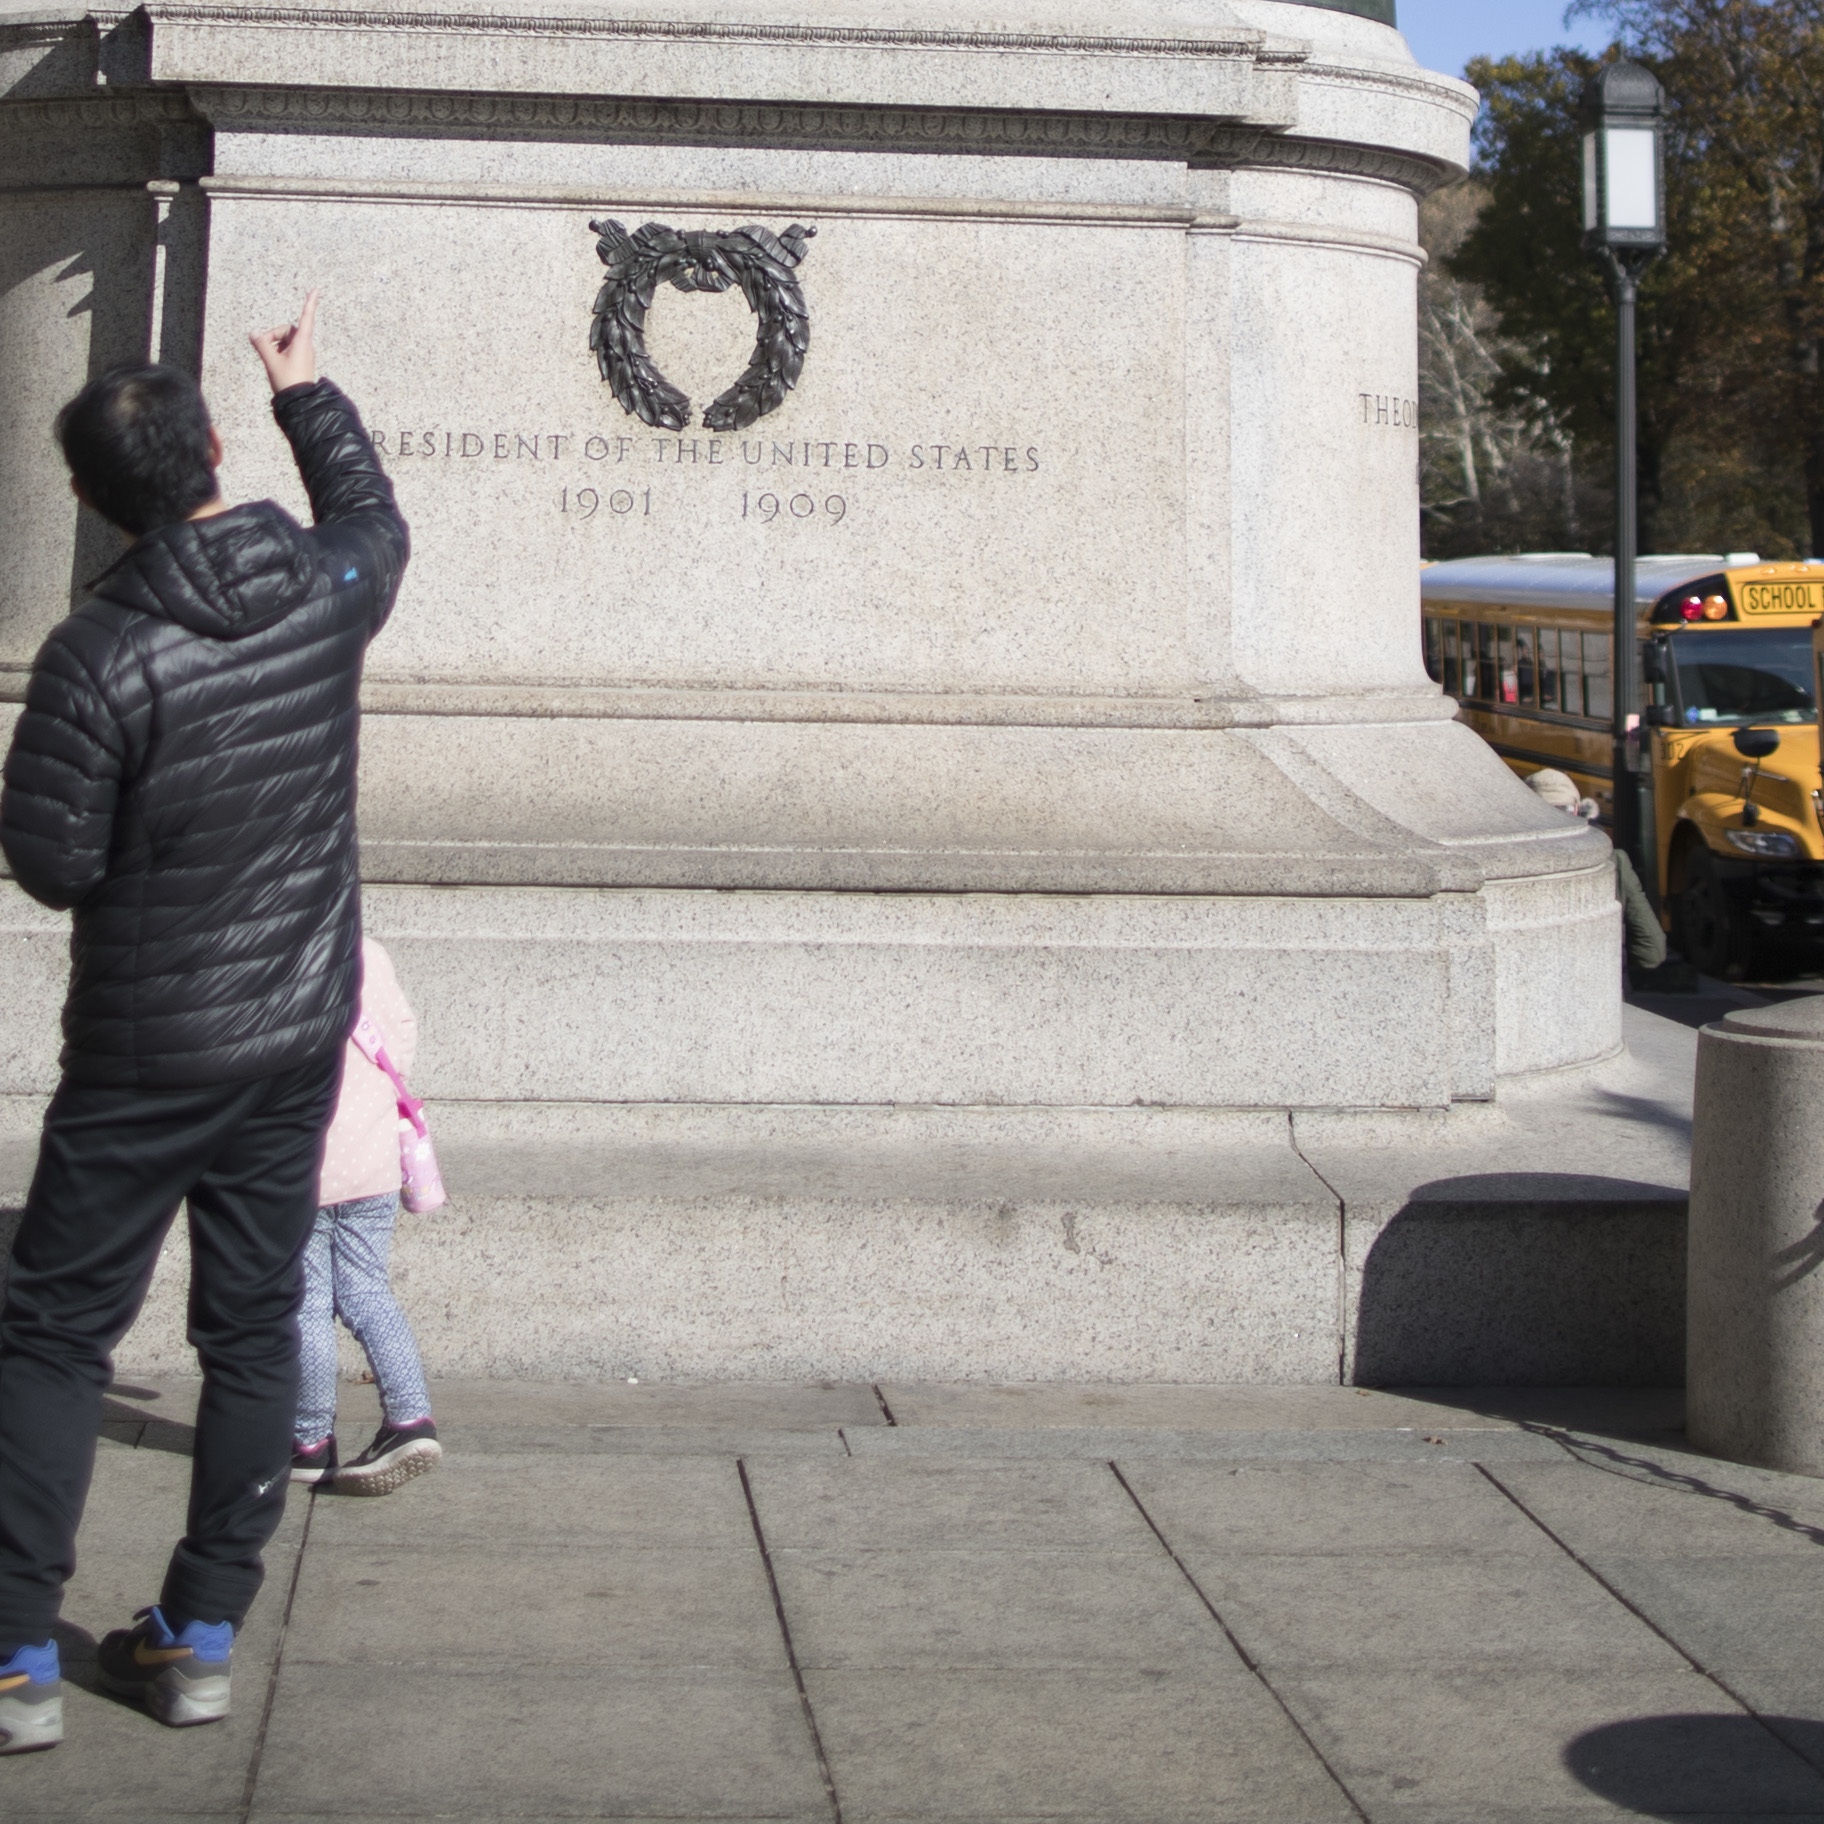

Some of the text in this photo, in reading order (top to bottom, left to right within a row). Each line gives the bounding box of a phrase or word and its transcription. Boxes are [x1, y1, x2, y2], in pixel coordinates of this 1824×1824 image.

[370, 429, 1040, 474] RESIDENT OF THE UNITED STATES
[559, 485, 847, 527] 1901 1909
[1749, 585, 1816, 610] SCHOOL
